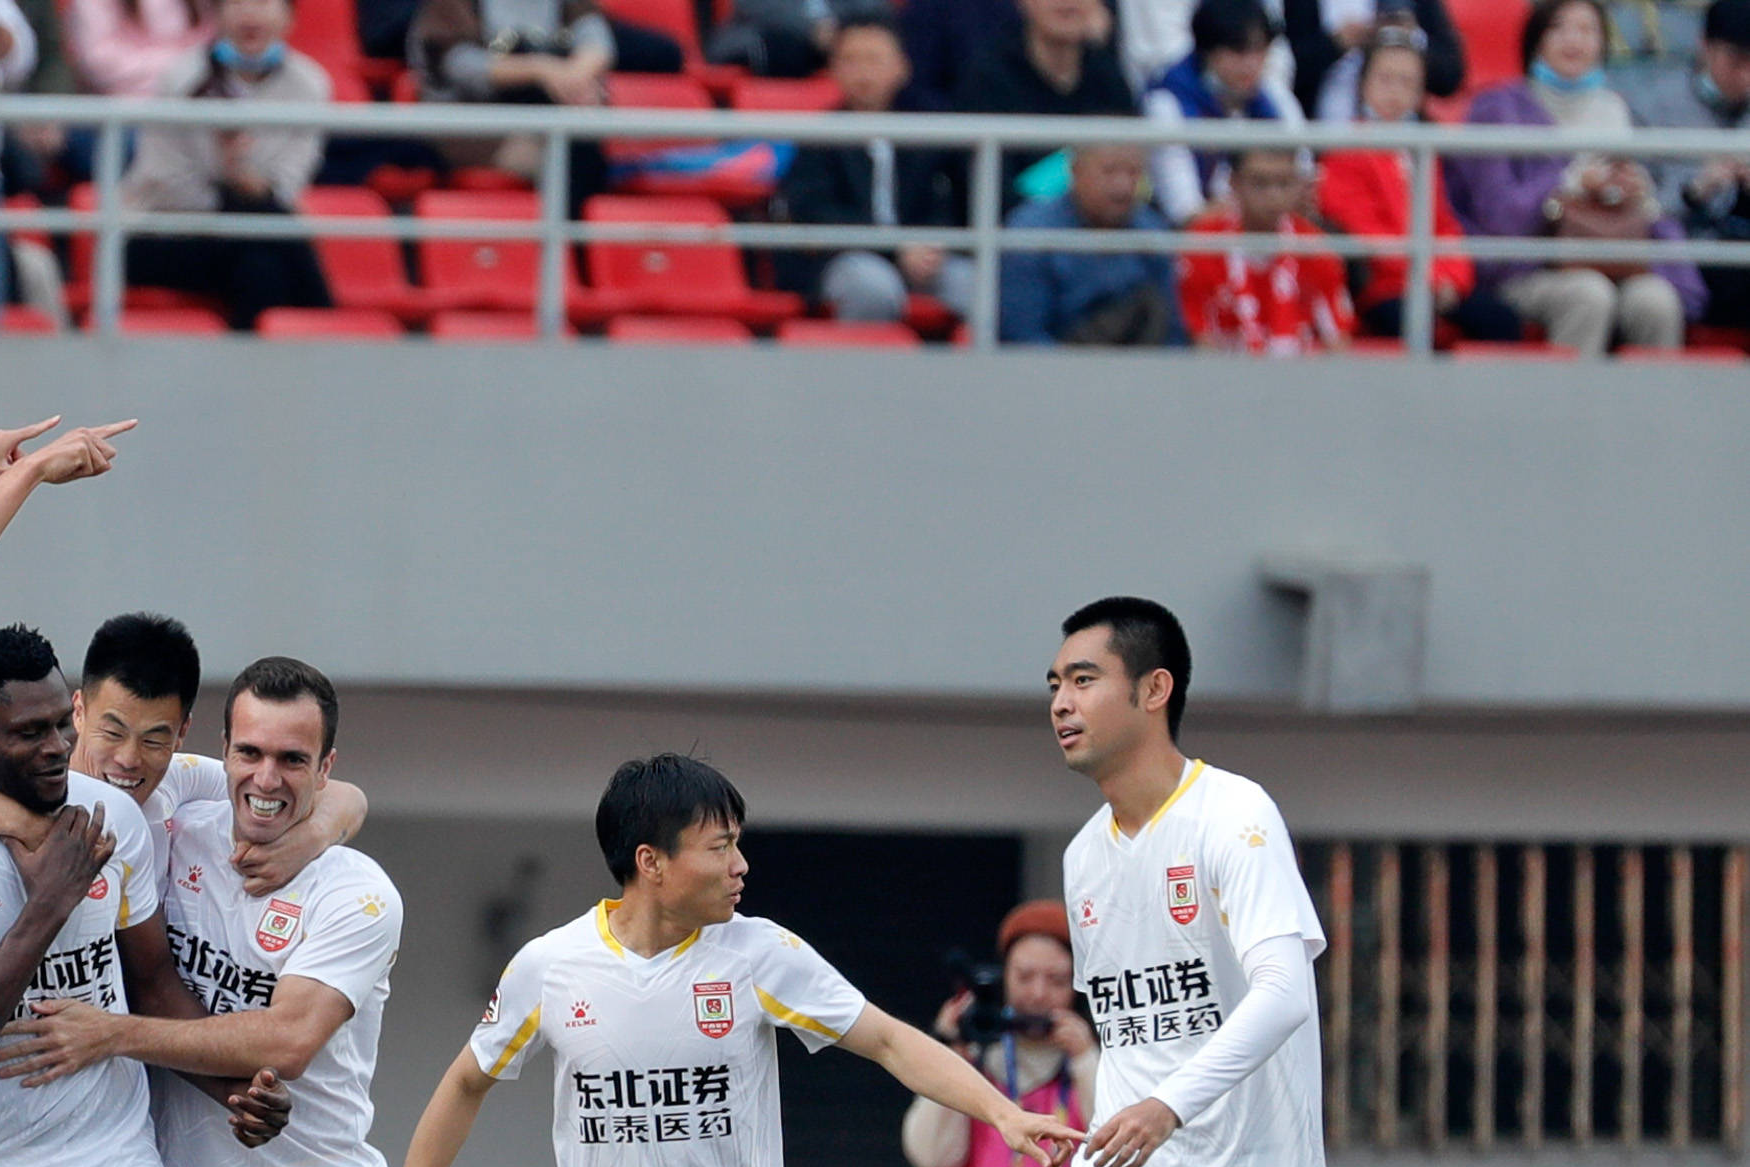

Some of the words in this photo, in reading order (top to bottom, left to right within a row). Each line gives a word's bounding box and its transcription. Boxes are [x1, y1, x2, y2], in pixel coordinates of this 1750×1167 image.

[1087, 958, 1211, 1014] 东北证券
[565, 1018, 597, 1028] KELME
[573, 1064, 730, 1109] 东北证券
[579, 1108, 733, 1144] 亚泰医药
